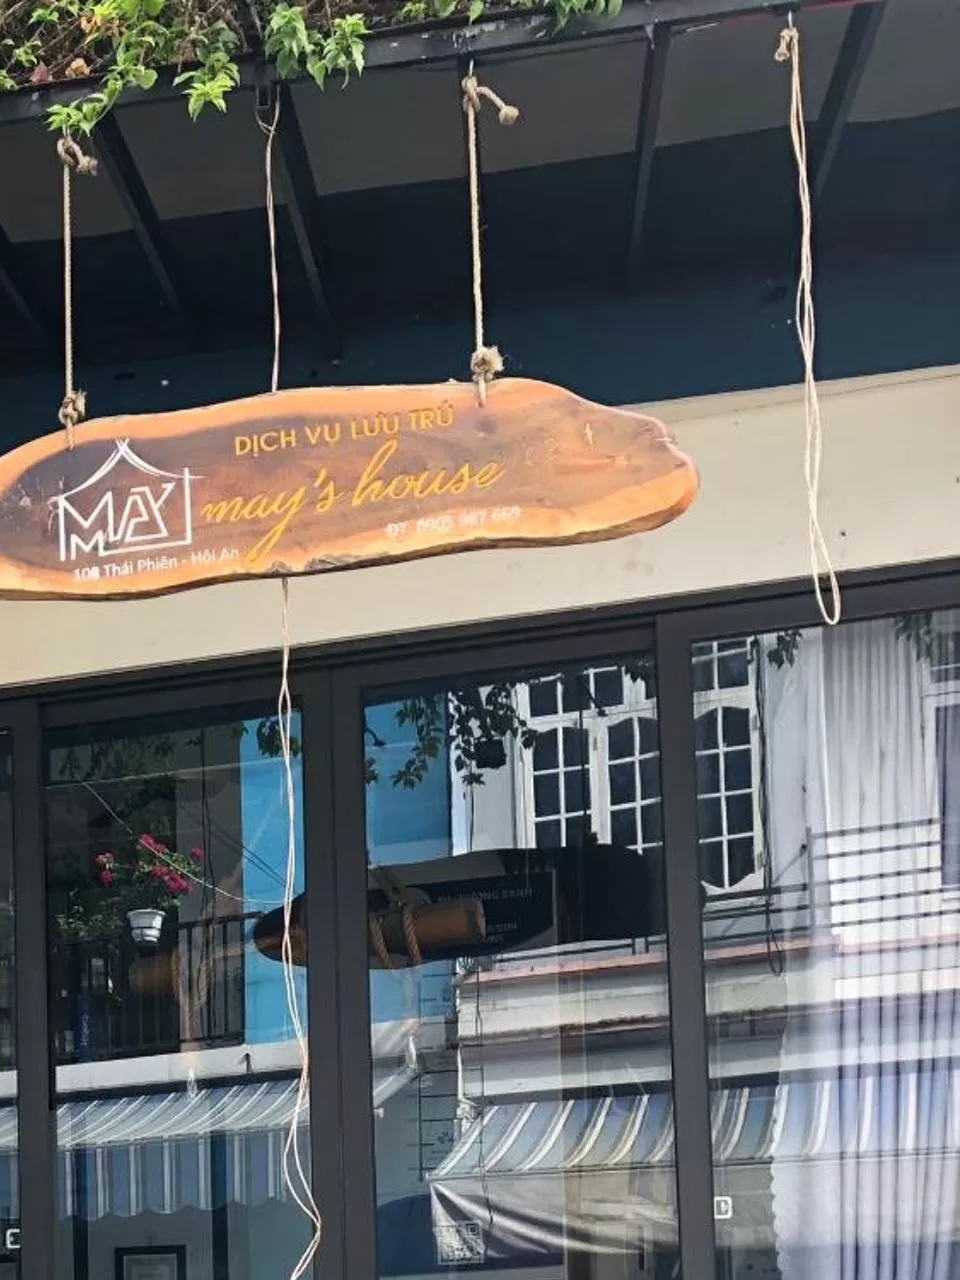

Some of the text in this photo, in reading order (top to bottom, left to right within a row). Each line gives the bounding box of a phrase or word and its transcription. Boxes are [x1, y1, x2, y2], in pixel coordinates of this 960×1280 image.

[200, 439, 507, 564] may's house
[104, 562, 134, 578] Thái
